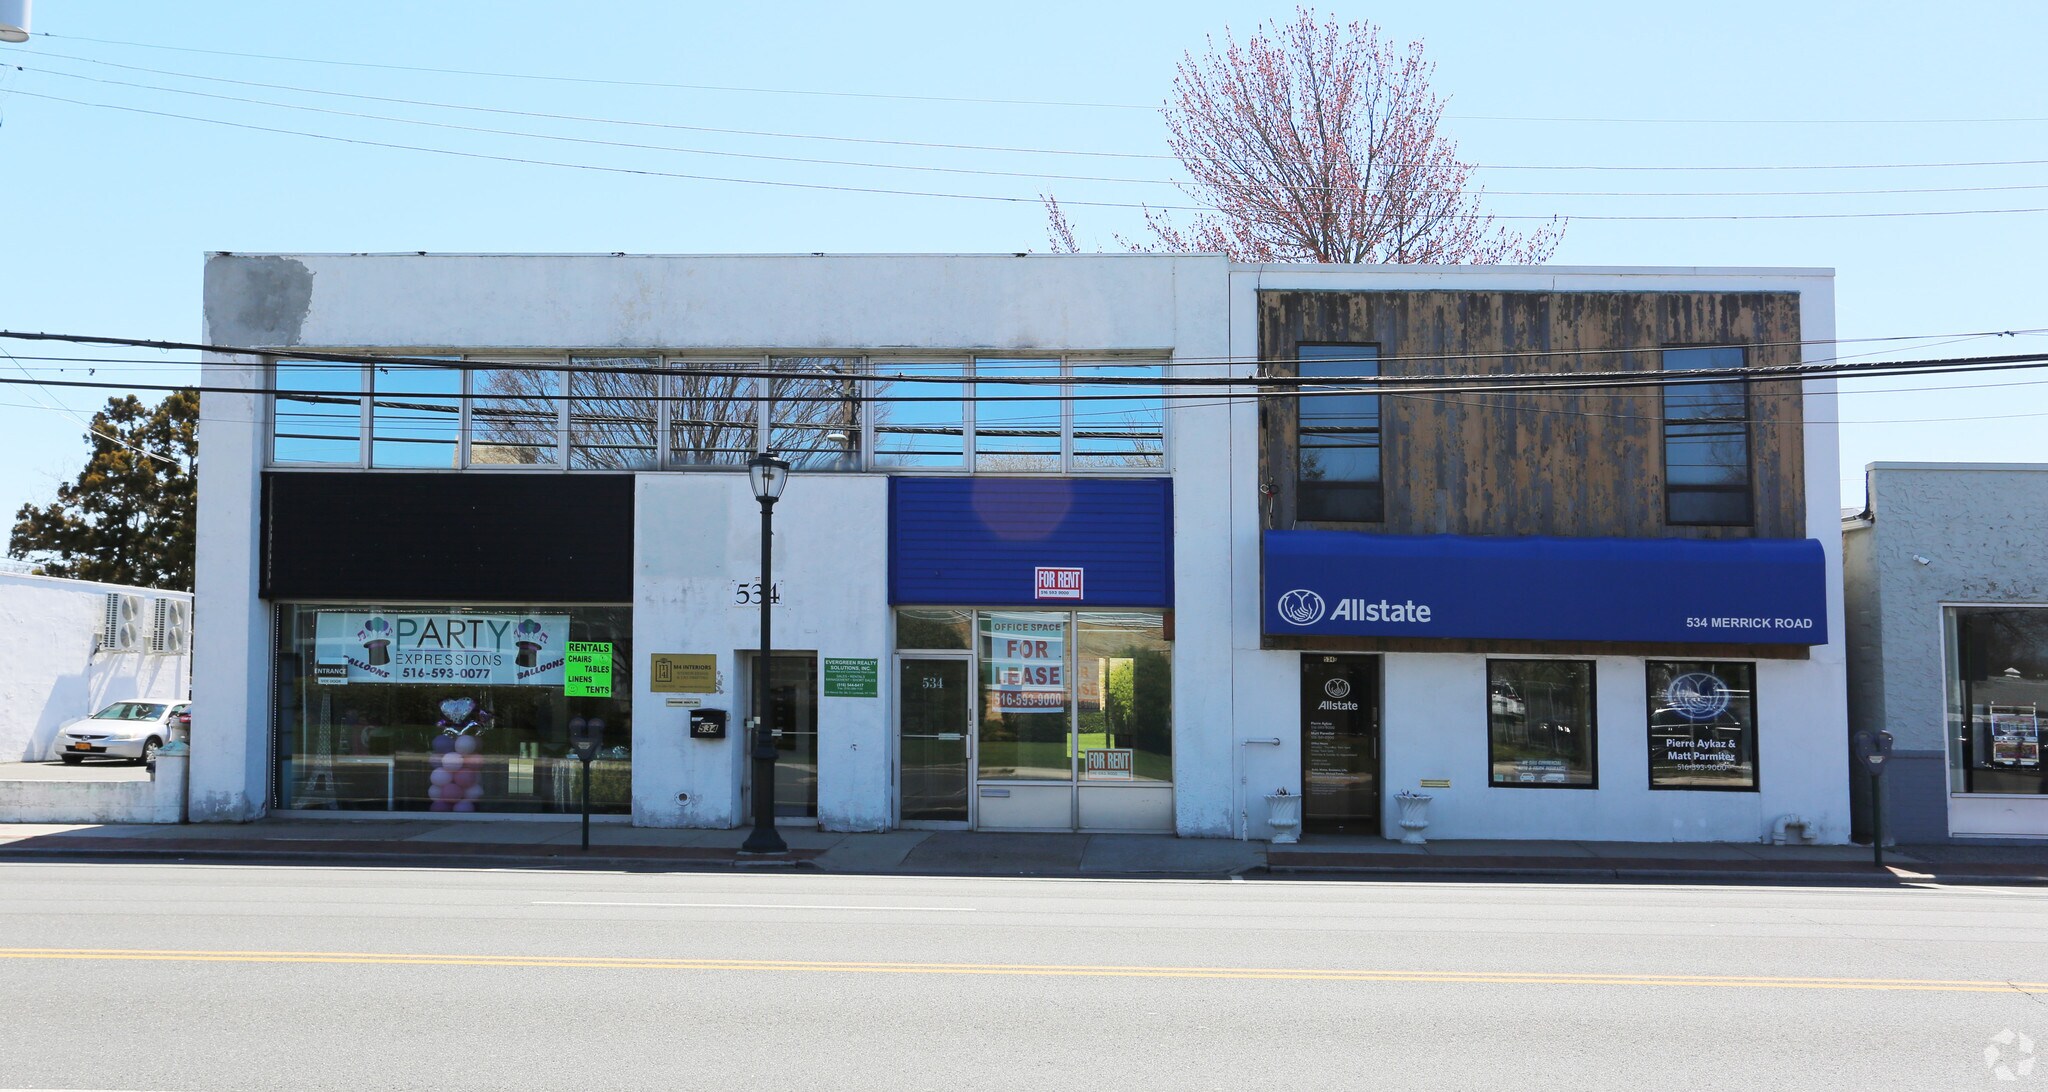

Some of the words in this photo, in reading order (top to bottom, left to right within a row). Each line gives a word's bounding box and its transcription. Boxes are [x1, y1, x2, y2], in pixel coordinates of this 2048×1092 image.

[1039, 571, 1055, 588] FOR
[1058, 571, 1080, 588] RENT
[736, 583, 780, 604] 534
[1330, 599, 1431, 623] Allstate
[994, 623, 1028, 631] OFFICE
[1686, 617, 1708, 628] 534
[1711, 618, 1771, 628] MERRICK
[1775, 618, 1813, 629] ROAD
[397, 618, 511, 652] PARTY
[569, 643, 609, 652] RENTALS
[1007, 640, 1048, 658] FOR
[396, 653, 502, 666] EXPRESSIONS
[568, 655, 592, 663] CHAIRS
[315, 667, 347, 675] ENTRANCE
[343, 655, 390, 678] ALLOONS
[517, 658, 564, 680] BALLOONS
[585, 665, 610, 673] TABLES
[402, 668, 491, 678] 516-593-0077
[568, 675, 592, 683] LINENS
[995, 667, 1060, 685] LEASE
[922, 677, 943, 689] 534
[586, 686, 610, 694] TENTS
[994, 692, 1061, 706] 516-593-9000
[1318, 701, 1358, 710] Allstate
[1666, 739, 1693, 748] Pierre
[1697, 739, 1726, 750] Aykaz
[1728, 740, 1736, 748] &
[1089, 752, 1105, 769] FOR
[1107, 752, 1129, 769] RENT
[1668, 752, 1691, 760] Matt
[1693, 752, 1735, 761] Parmiter
